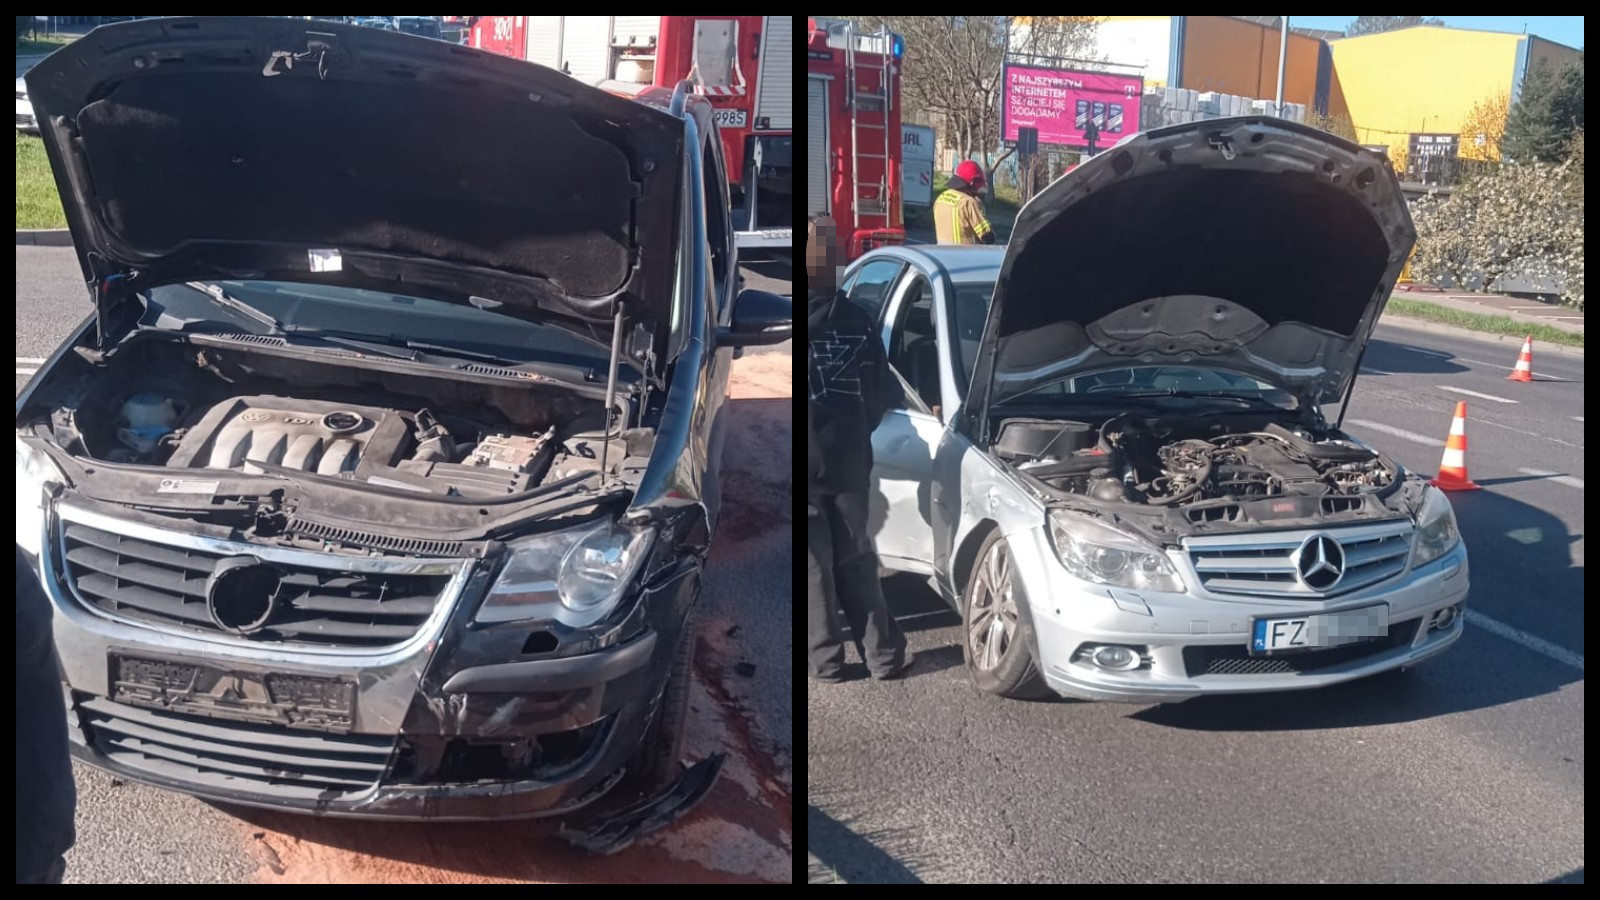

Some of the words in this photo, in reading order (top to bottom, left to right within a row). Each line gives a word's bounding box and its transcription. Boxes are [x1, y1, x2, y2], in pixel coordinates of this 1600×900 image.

[1011, 74, 1018, 83] Z
[1011, 85, 1067, 99] INTERNETEM
[1011, 96, 1052, 108] SZYBCIEJ
[1053, 99, 1067, 111] SIĘ
[1011, 106, 1062, 119] DOGADAMY
[1271, 620, 1306, 648] FZ
